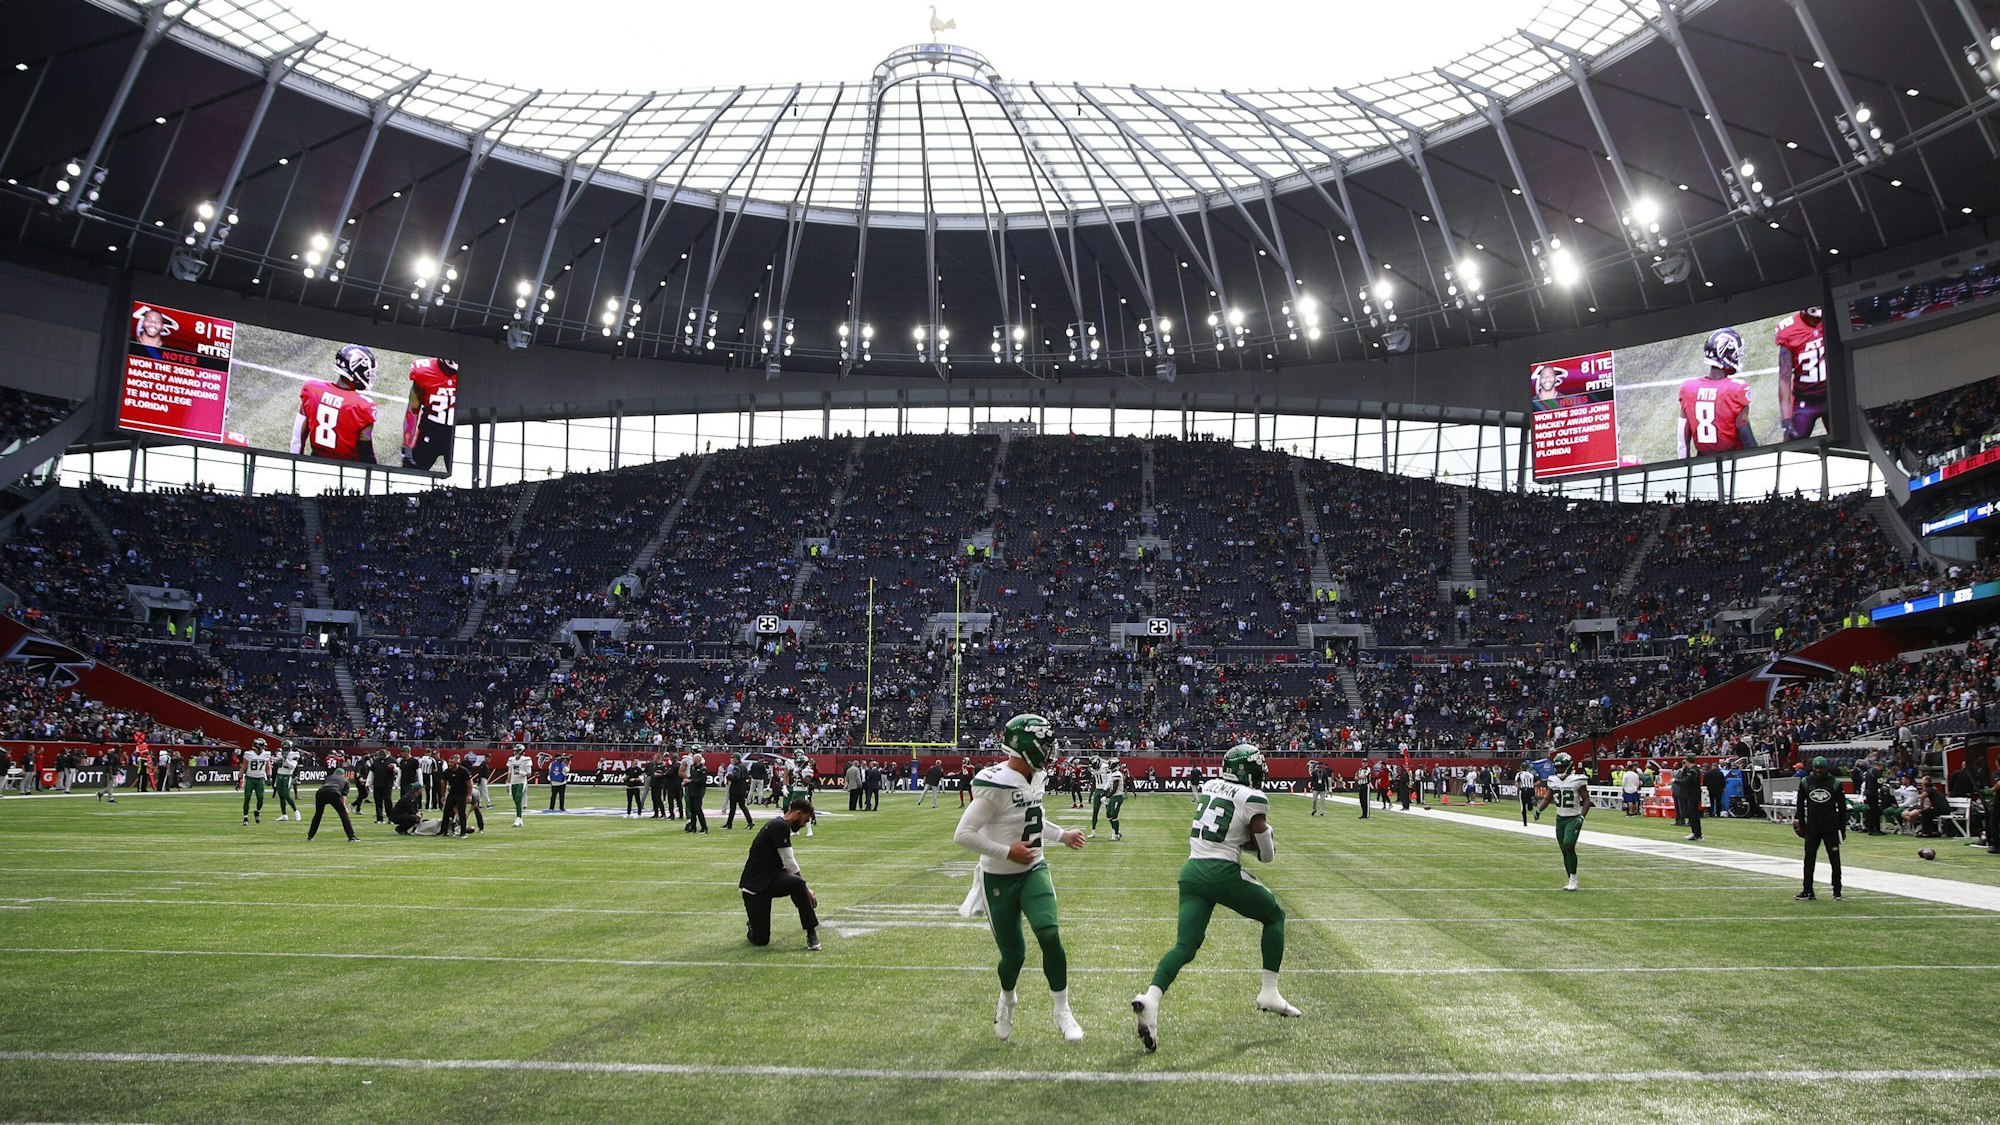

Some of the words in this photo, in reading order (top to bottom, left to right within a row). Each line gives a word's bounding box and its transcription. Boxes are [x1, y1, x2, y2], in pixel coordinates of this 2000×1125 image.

[197, 343, 230, 358] PITTS
[214, 340, 231, 349] KYLE
[162, 351, 198, 365] NOTES
[129, 358, 152, 370] WON
[154, 362, 172, 373] THE
[173, 366, 195, 377] 2020
[196, 371, 221, 381] JOHN
[128, 368, 167, 381] MACKEY
[168, 375, 200, 388] AWARD
[202, 381, 220, 391] FOR
[1586, 379, 1613, 391] PITTS
[127, 378, 154, 388] MOST
[155, 382, 219, 400] OUTSTANDING
[1697, 387, 1718, 400] PITTS
[126, 388, 138, 397] TE
[139, 390, 149, 399] IN
[151, 392, 192, 406] COLLEGE
[320, 391, 344, 409] PITTS
[1559, 395, 1588, 407] NOTES
[124, 398, 168, 412] (FLORIDA)
[1534, 412, 1552, 421] WON
[1554, 409, 1568, 419] THE
[1569, 407, 1587, 416] 2020
[1588, 404, 1609, 413] JOHN
[315, 403, 339, 449] 8
[1535, 420, 1566, 430] MACKEY
[1566, 417, 1593, 426] AWARD
[1594, 413, 1610, 422] FOR
[1695, 401, 1717, 443] 8
[1535, 430, 1556, 439] MOST
[1557, 423, 1609, 437] OUTSTANDING
[1536, 440, 1545, 449] TE
[1546, 439, 1554, 447] IN
[1555, 434, 1589, 446] COLLEGE
[1536, 447, 1571, 458] (FLORIDA)
[760, 618, 775, 630] 25
[1151, 621, 1167, 633] 25
[250, 760, 265, 770] 87
[327, 759, 337, 768] 34
[195, 771, 207, 782] Go
[209, 771, 230, 782] There
[567, 773, 596, 782] There
[1170, 766, 1223, 777] FALC
[1134, 780, 1159, 789] With
[1553, 789, 1574, 807] 32
[1190, 794, 1236, 843] 23
[1021, 806, 1044, 847] 2
